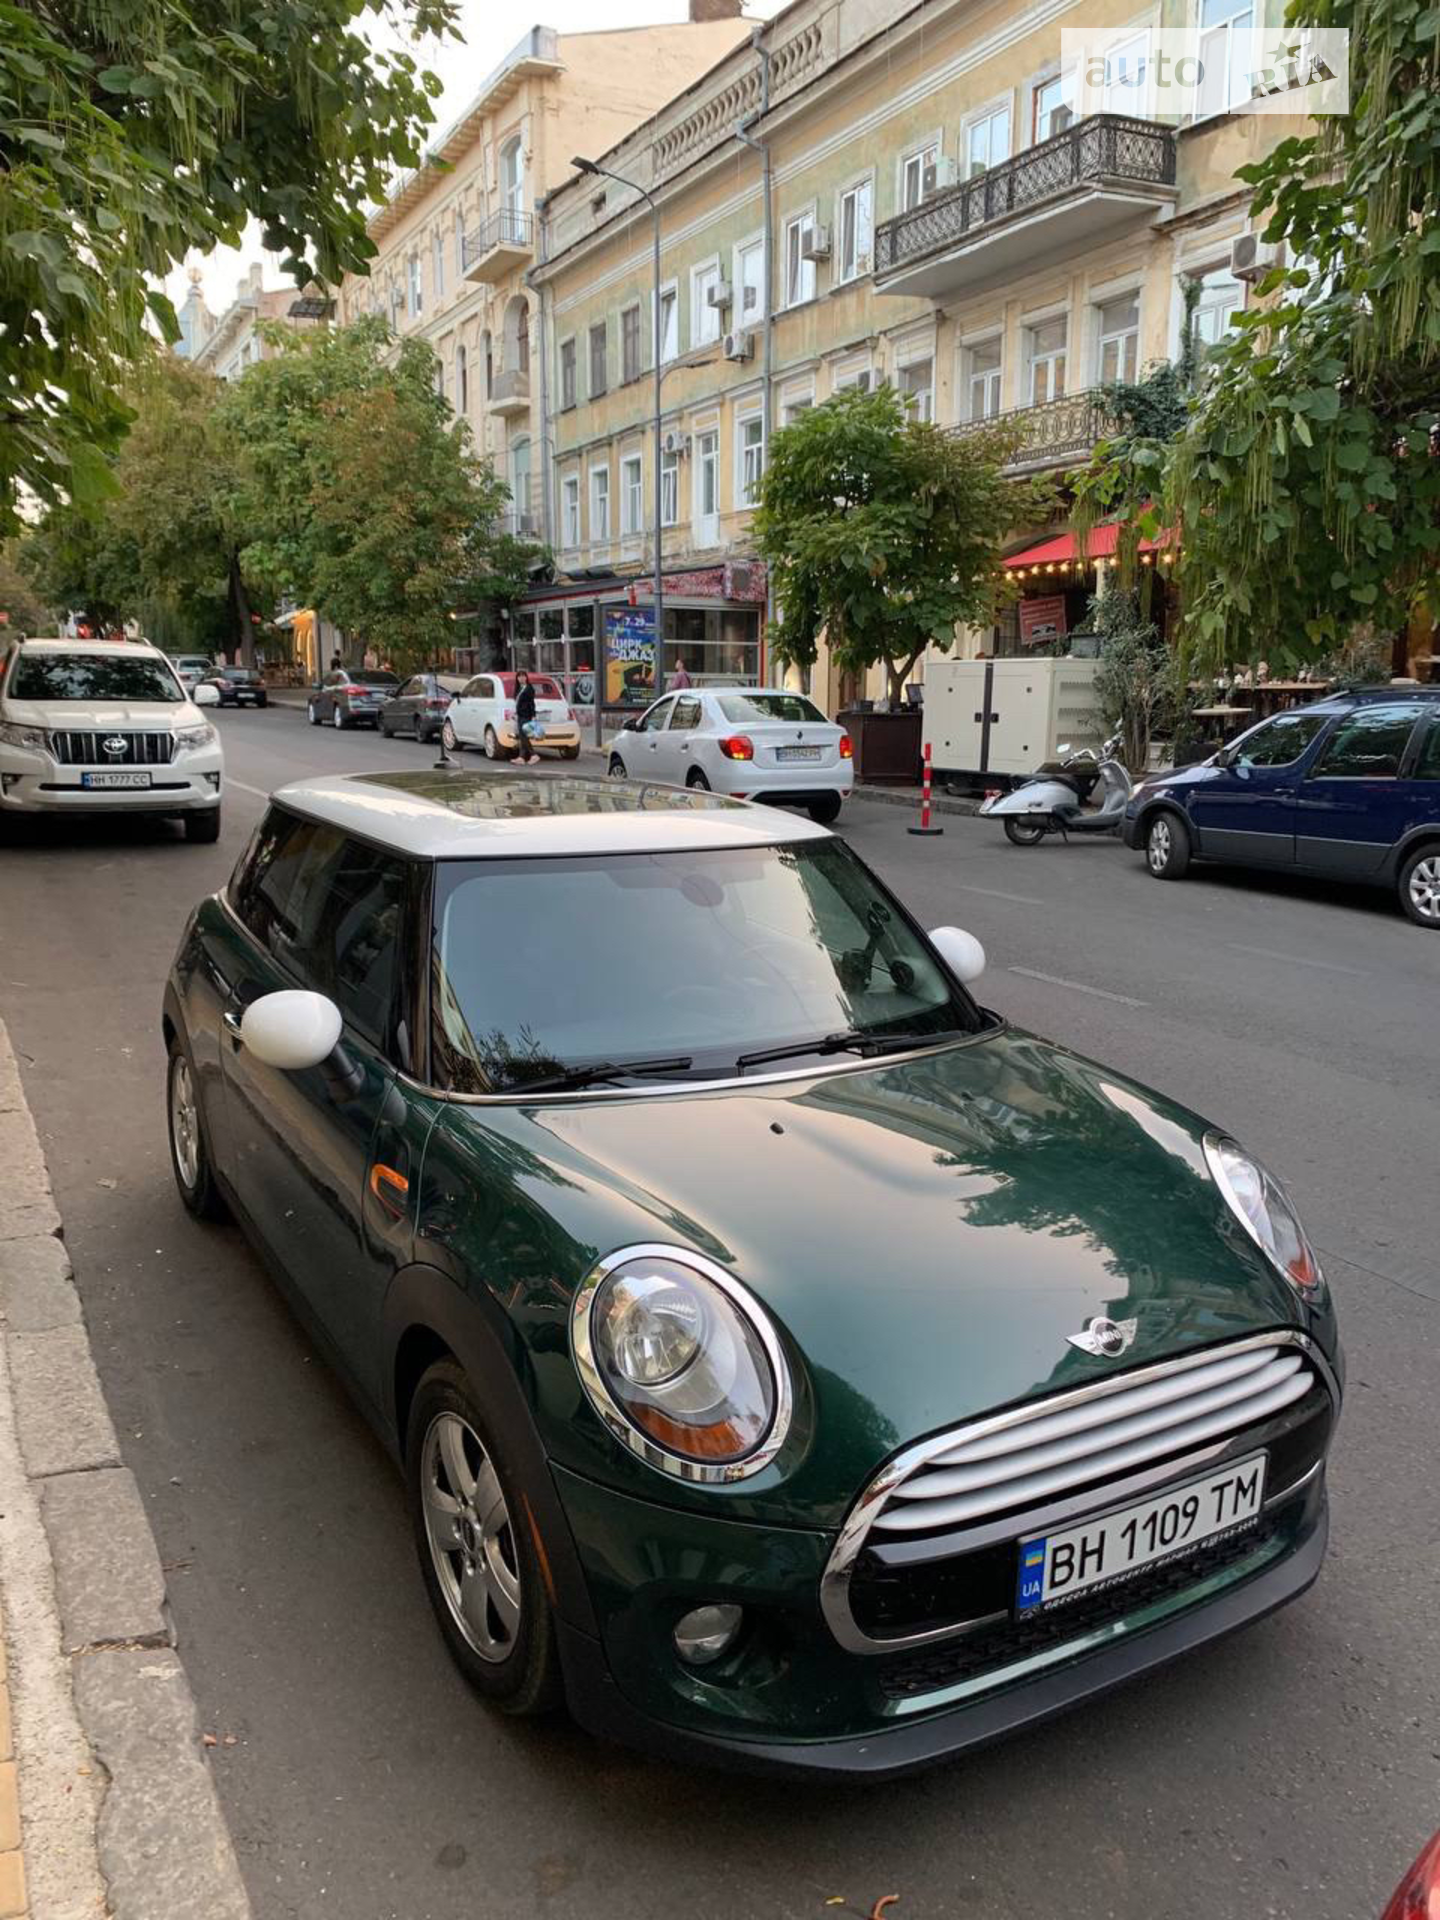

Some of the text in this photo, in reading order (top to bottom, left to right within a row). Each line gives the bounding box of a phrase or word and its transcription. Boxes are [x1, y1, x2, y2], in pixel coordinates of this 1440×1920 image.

[611, 638, 642, 651] ЦИРК
[1049, 1530, 1105, 1589] BH
[1120, 1495, 1199, 1560] 1109
[1210, 1468, 1258, 1523] TM
[1022, 1580, 1041, 1598] UA
